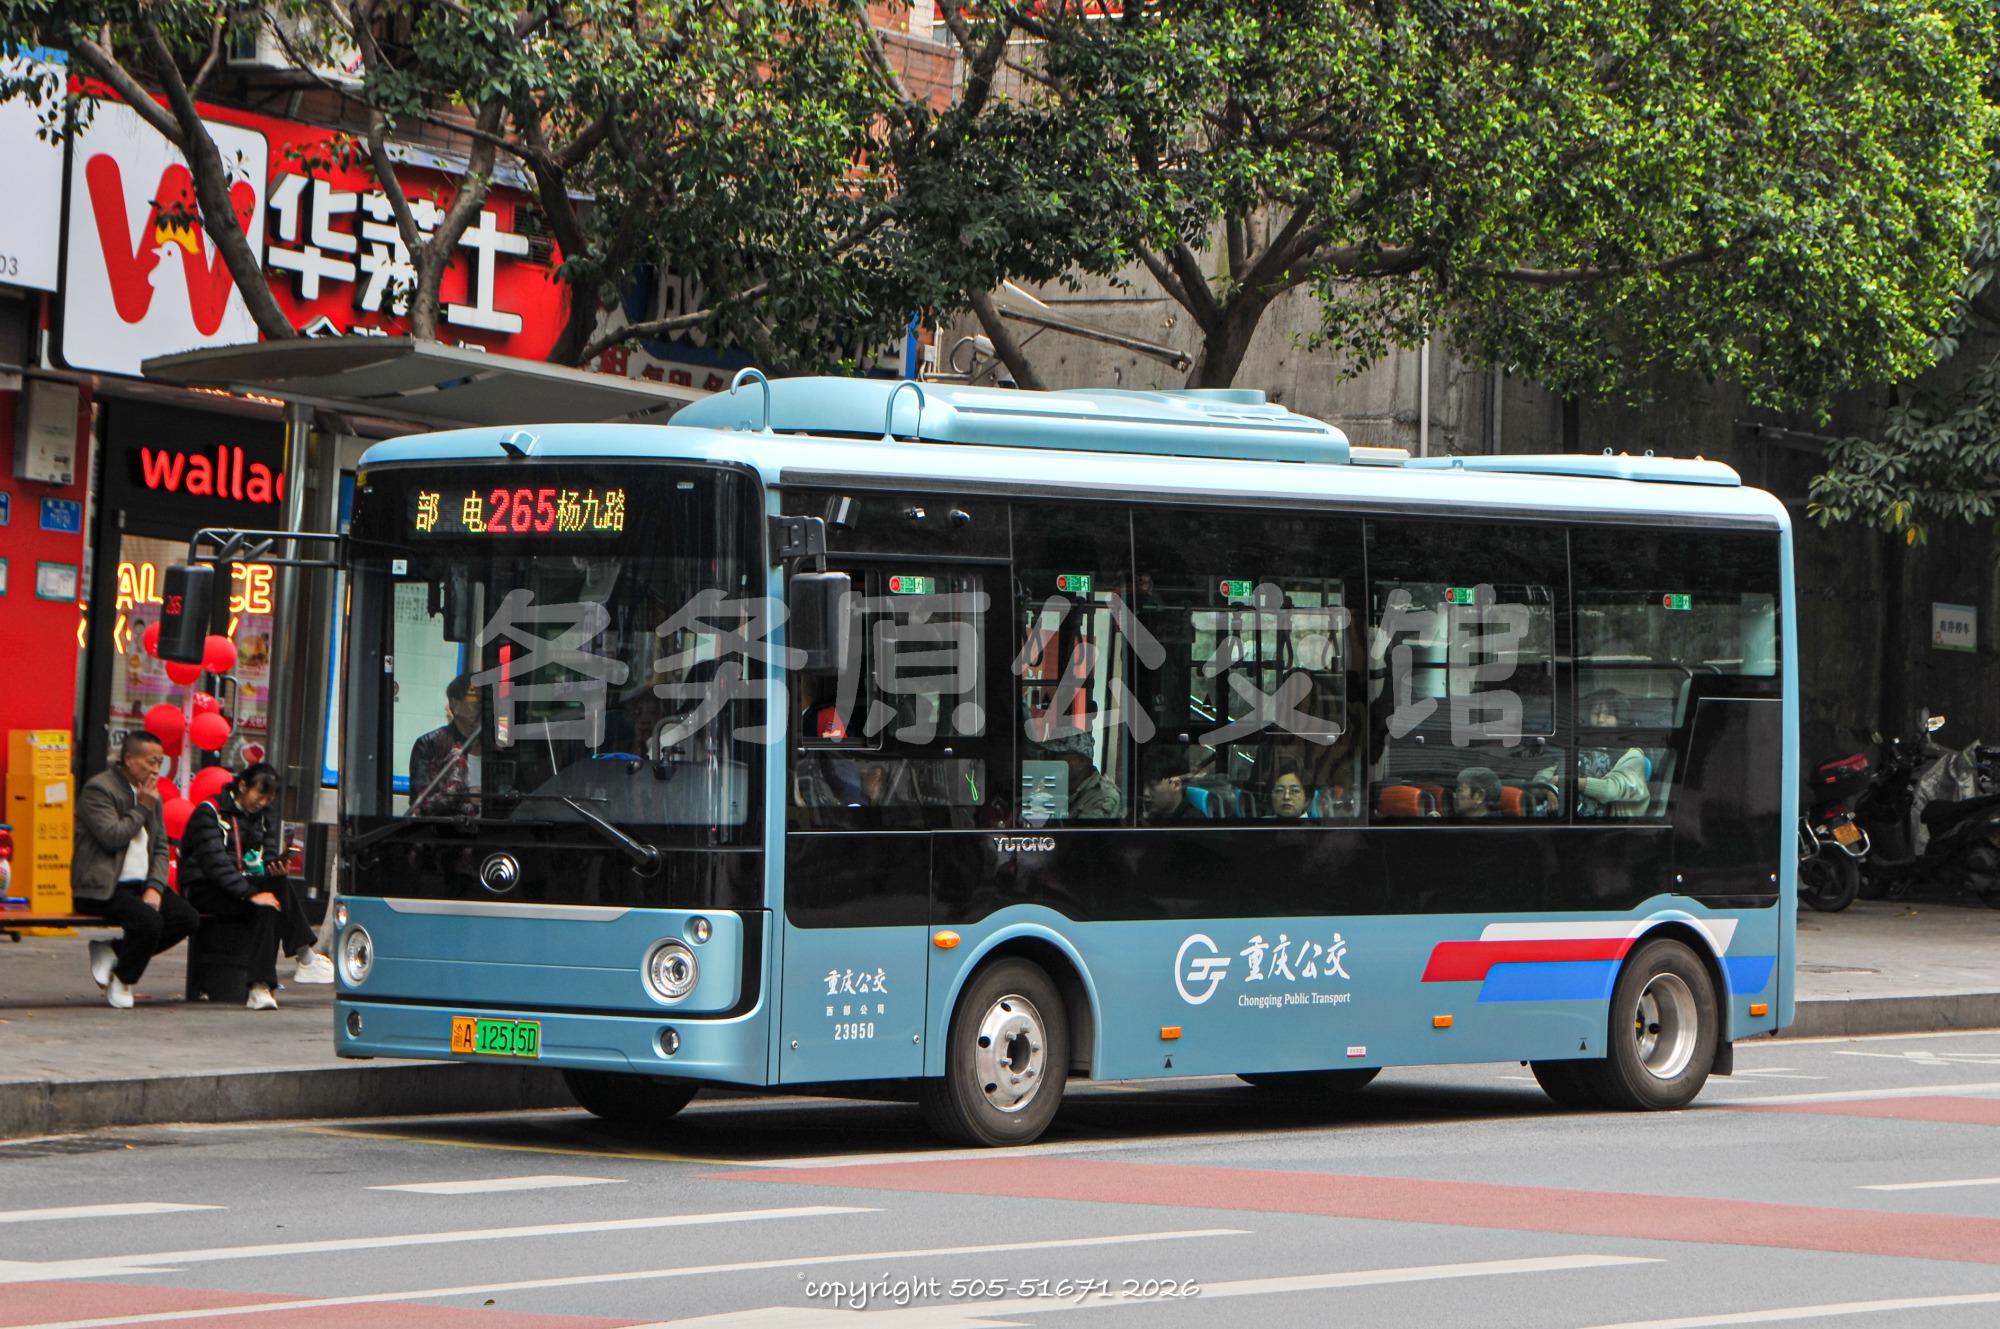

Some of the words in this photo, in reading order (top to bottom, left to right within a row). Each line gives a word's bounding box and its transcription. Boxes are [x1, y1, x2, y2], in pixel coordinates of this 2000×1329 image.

[488, 489, 557, 532] 265
[556, 488, 626, 532] 杨九路
[993, 837, 1056, 852] YUTONG
[1239, 932, 1351, 983] 重庆公交
[823, 967, 888, 996] 重庆公交
[1238, 994, 1283, 1009] Chongqing
[1284, 992, 1309, 1006] Public
[1311, 991, 1351, 1006] Transport
[834, 1022, 874, 1041] 23950
